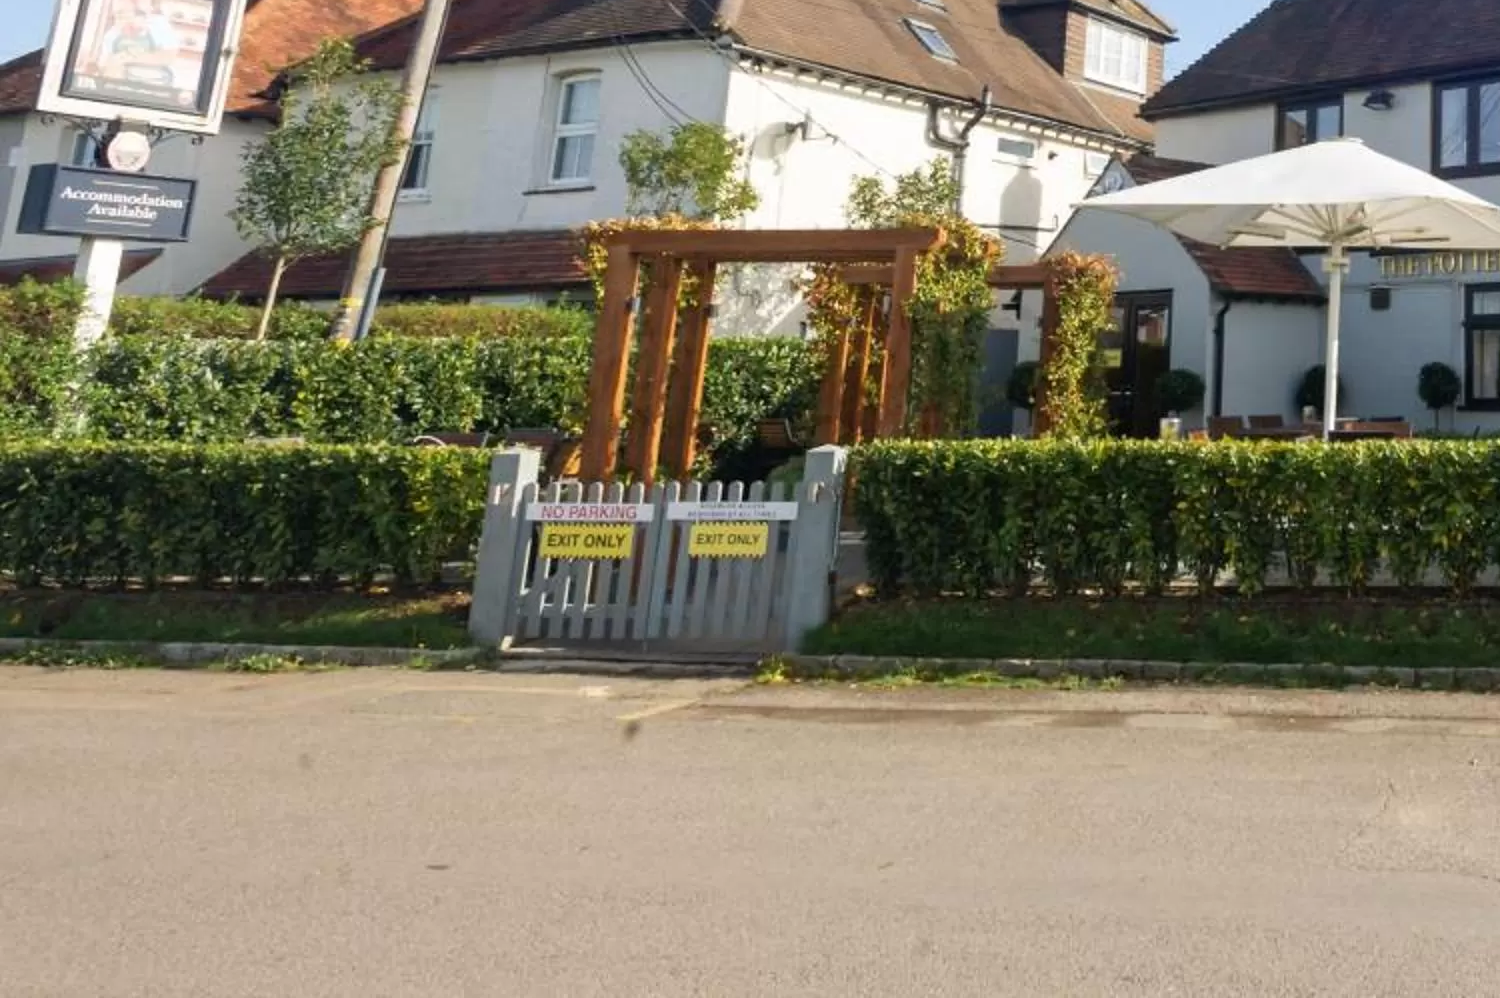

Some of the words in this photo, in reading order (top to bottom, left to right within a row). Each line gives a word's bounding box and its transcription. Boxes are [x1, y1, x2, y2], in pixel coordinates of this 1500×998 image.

[60, 185, 184, 210] Accommodation
[86, 202, 158, 220] Available
[1379, 254, 1419, 277] THE
[540, 505, 566, 519] NO
[569, 505, 638, 519] PARKING
[546, 533, 580, 547] EXIT
[583, 533, 627, 548] ONLY
[695, 533, 723, 545] EXIT
[727, 533, 761, 545] ONLY
